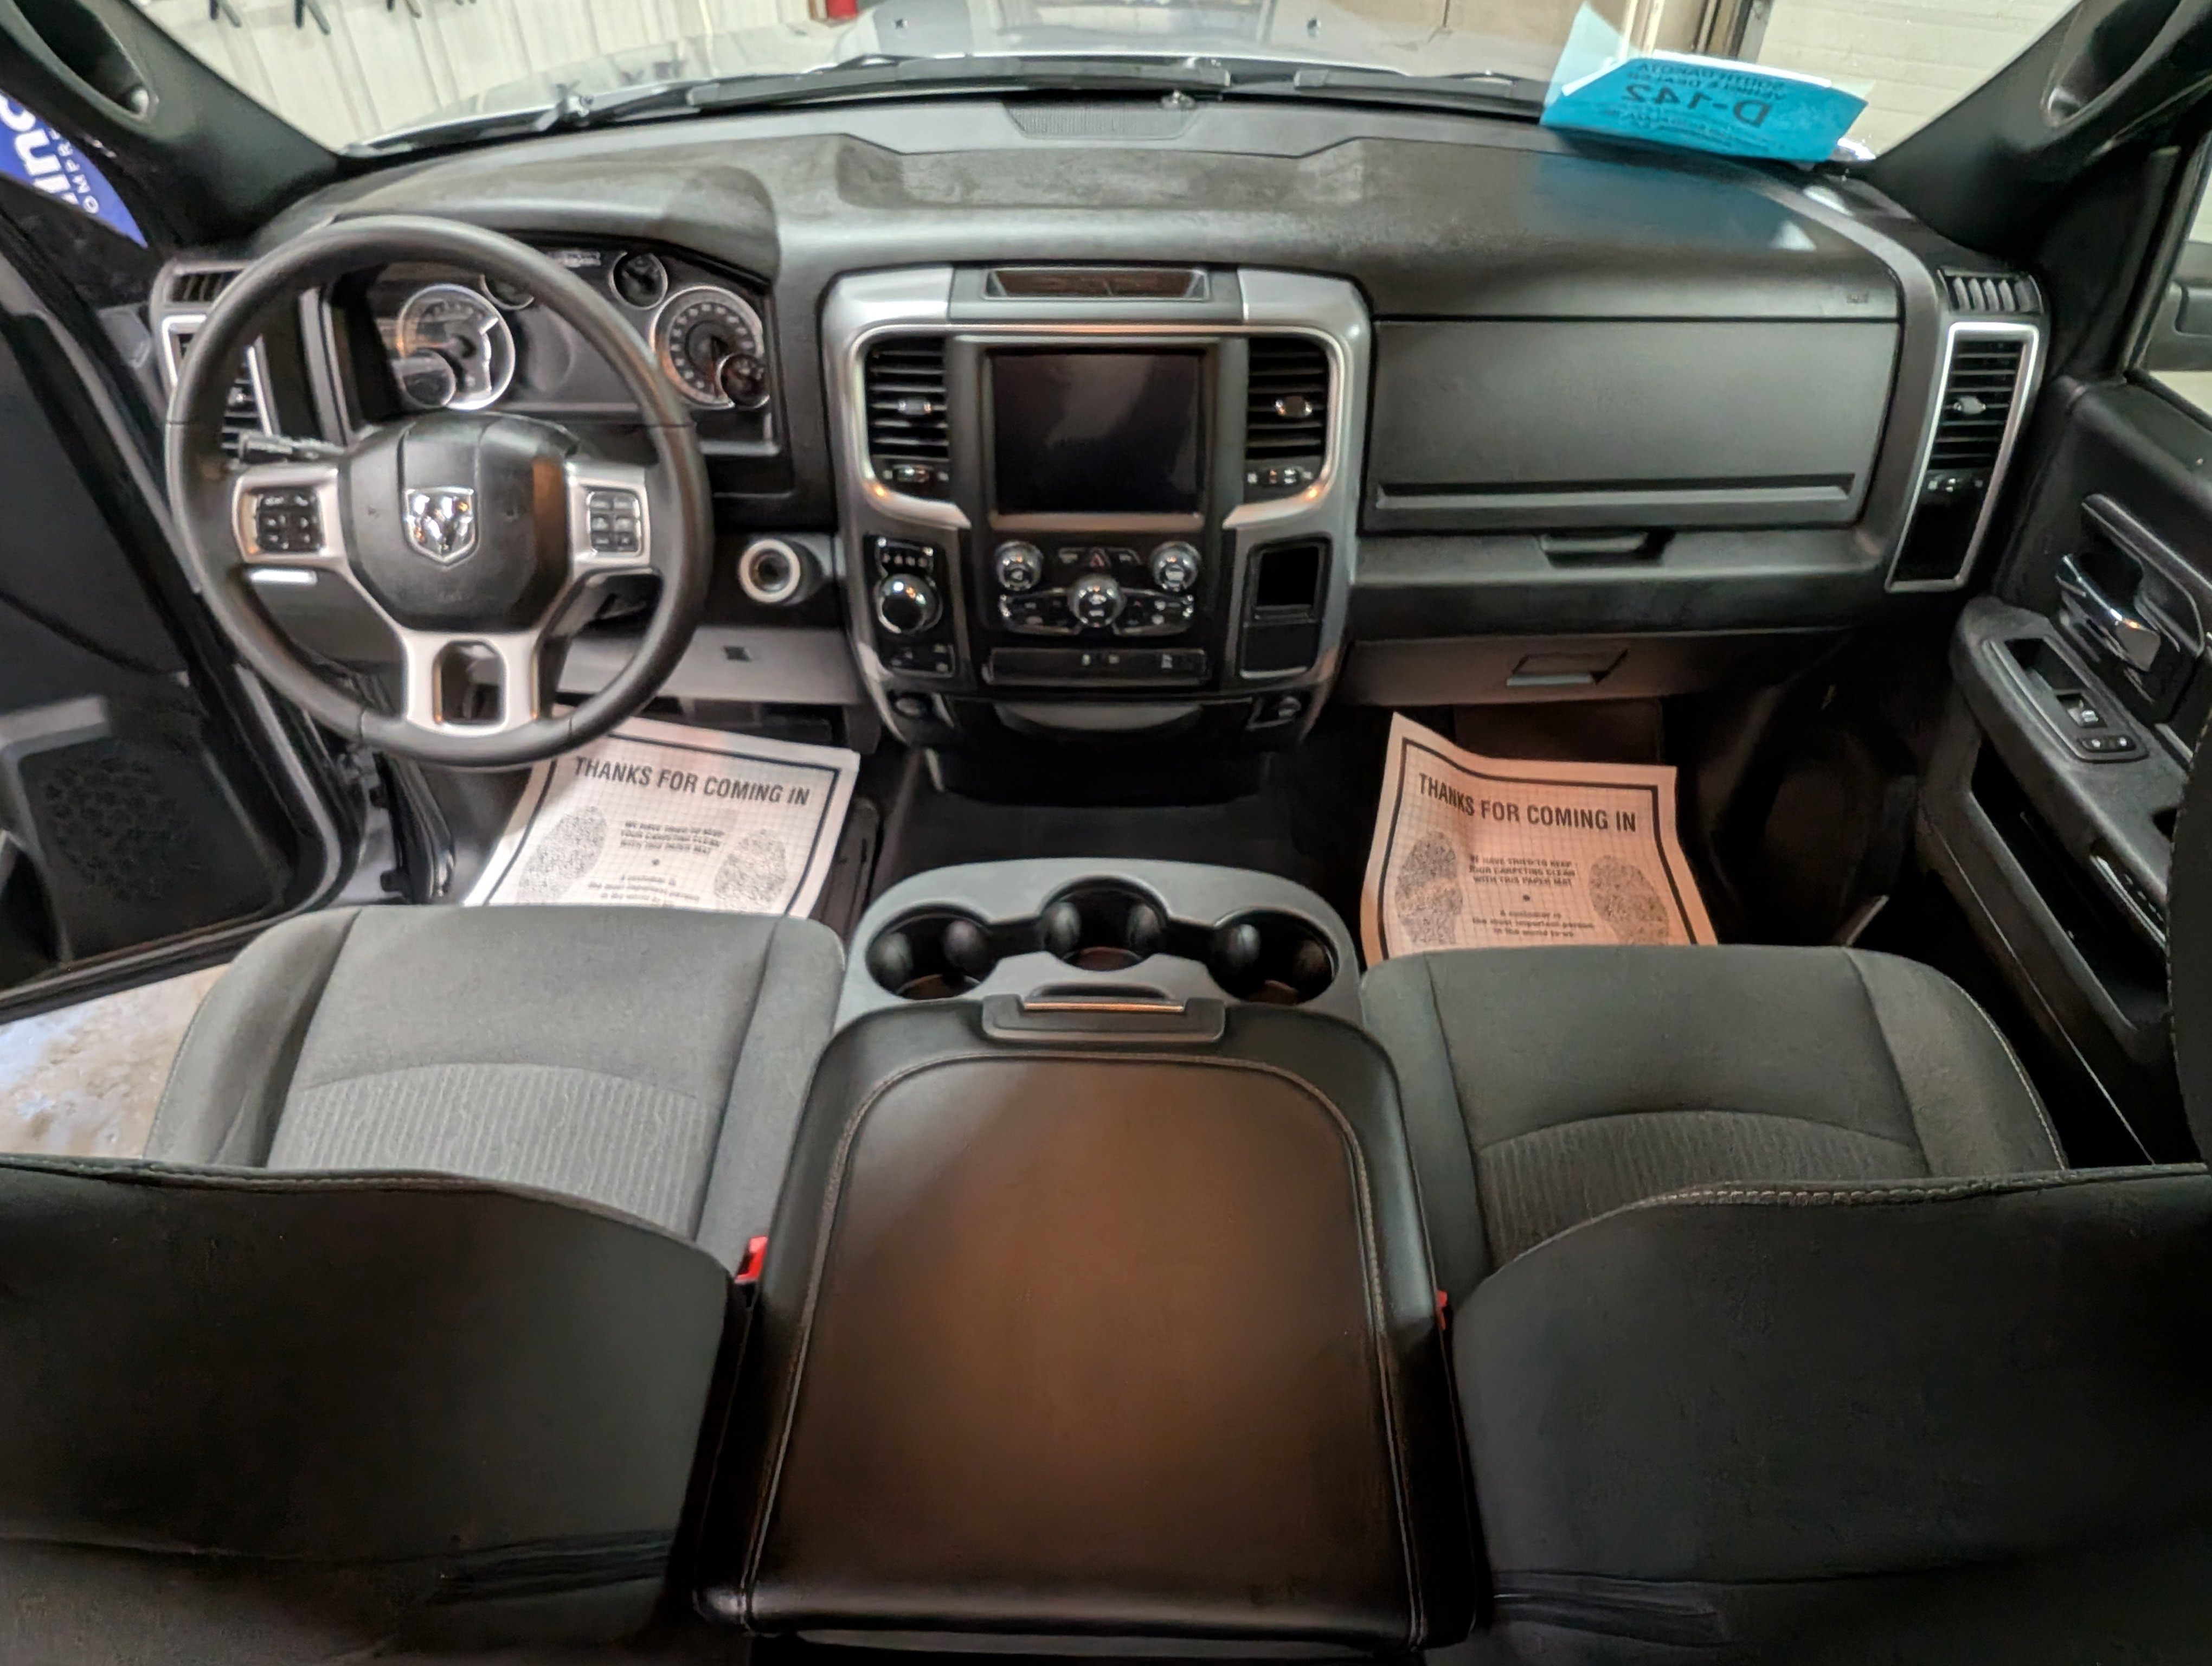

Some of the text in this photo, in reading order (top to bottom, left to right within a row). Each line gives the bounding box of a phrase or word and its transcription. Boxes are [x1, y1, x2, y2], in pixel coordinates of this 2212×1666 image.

[575, 756, 811, 806] THANKS FOR COMING IN
[1418, 773, 1636, 832] THANKS FOR COMING IN
